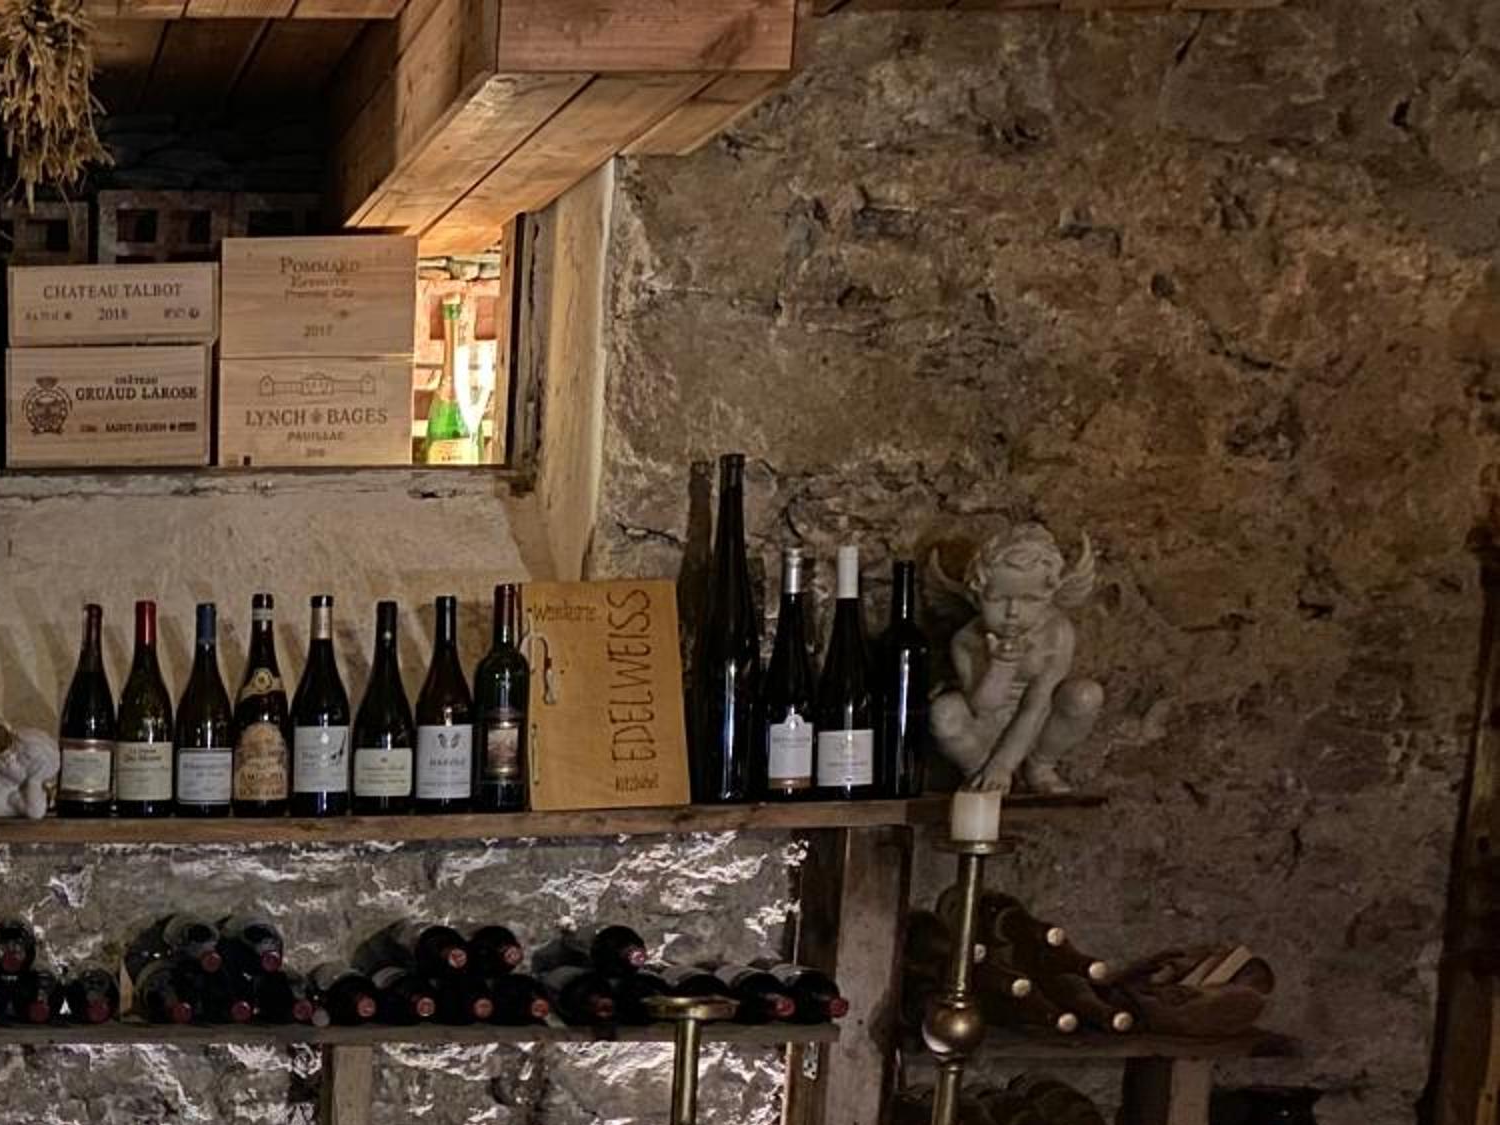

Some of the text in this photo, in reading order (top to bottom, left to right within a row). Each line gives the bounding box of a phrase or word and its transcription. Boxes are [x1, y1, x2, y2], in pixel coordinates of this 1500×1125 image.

[43, 282, 183, 300] CHATEAU TALBOT
[75, 386, 197, 401] GRUAUD LAROSE
[245, 407, 388, 427] LYNCH BAGES
[606, 588, 657, 764] EDELWEISS
